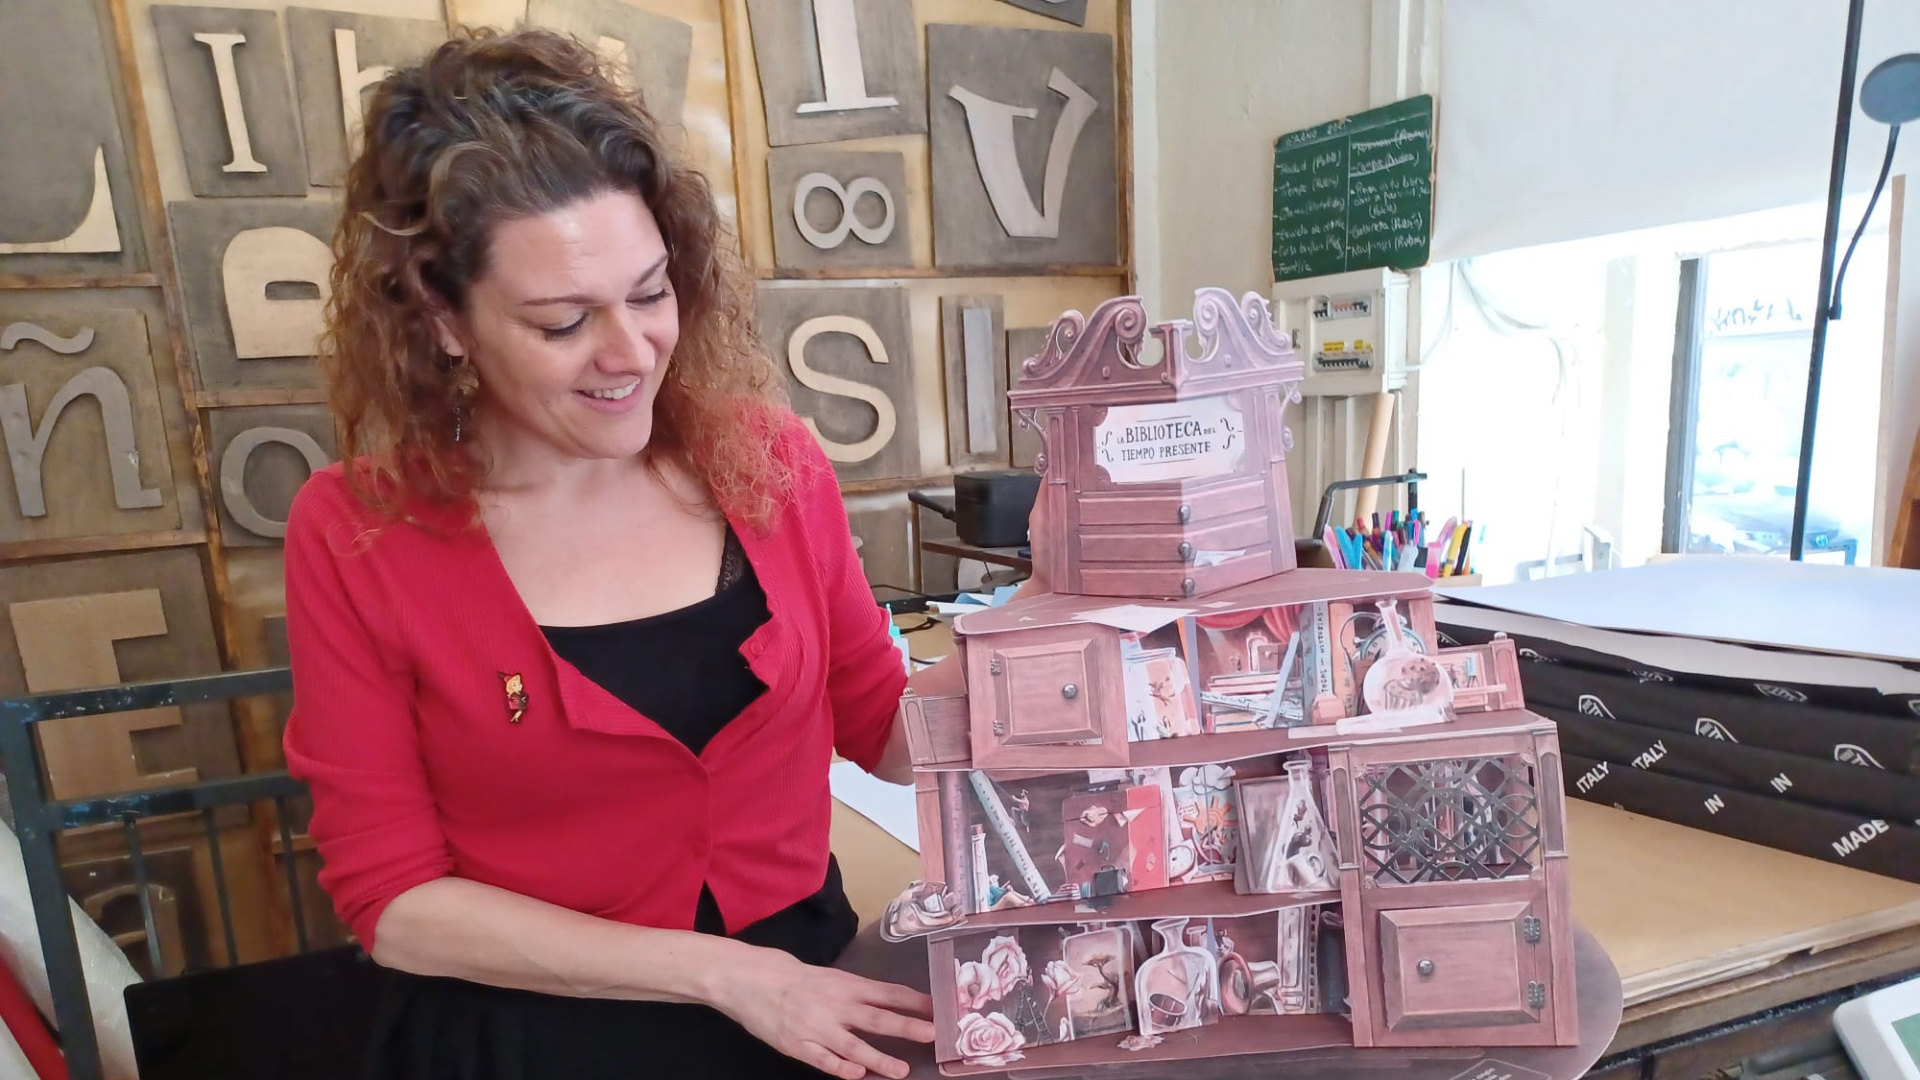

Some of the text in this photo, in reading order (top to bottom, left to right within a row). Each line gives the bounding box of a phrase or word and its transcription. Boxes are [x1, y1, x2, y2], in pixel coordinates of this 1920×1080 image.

[1117, 420, 1217, 444] LA BIBLIOTECA DEL
[1121, 441, 1212, 462] TIEMPO PRESENTE
[1576, 761, 1610, 794] ITALY
[1770, 772, 1793, 793] IN
[1704, 794, 1725, 815] IN
[1832, 819, 1890, 857] MADE
